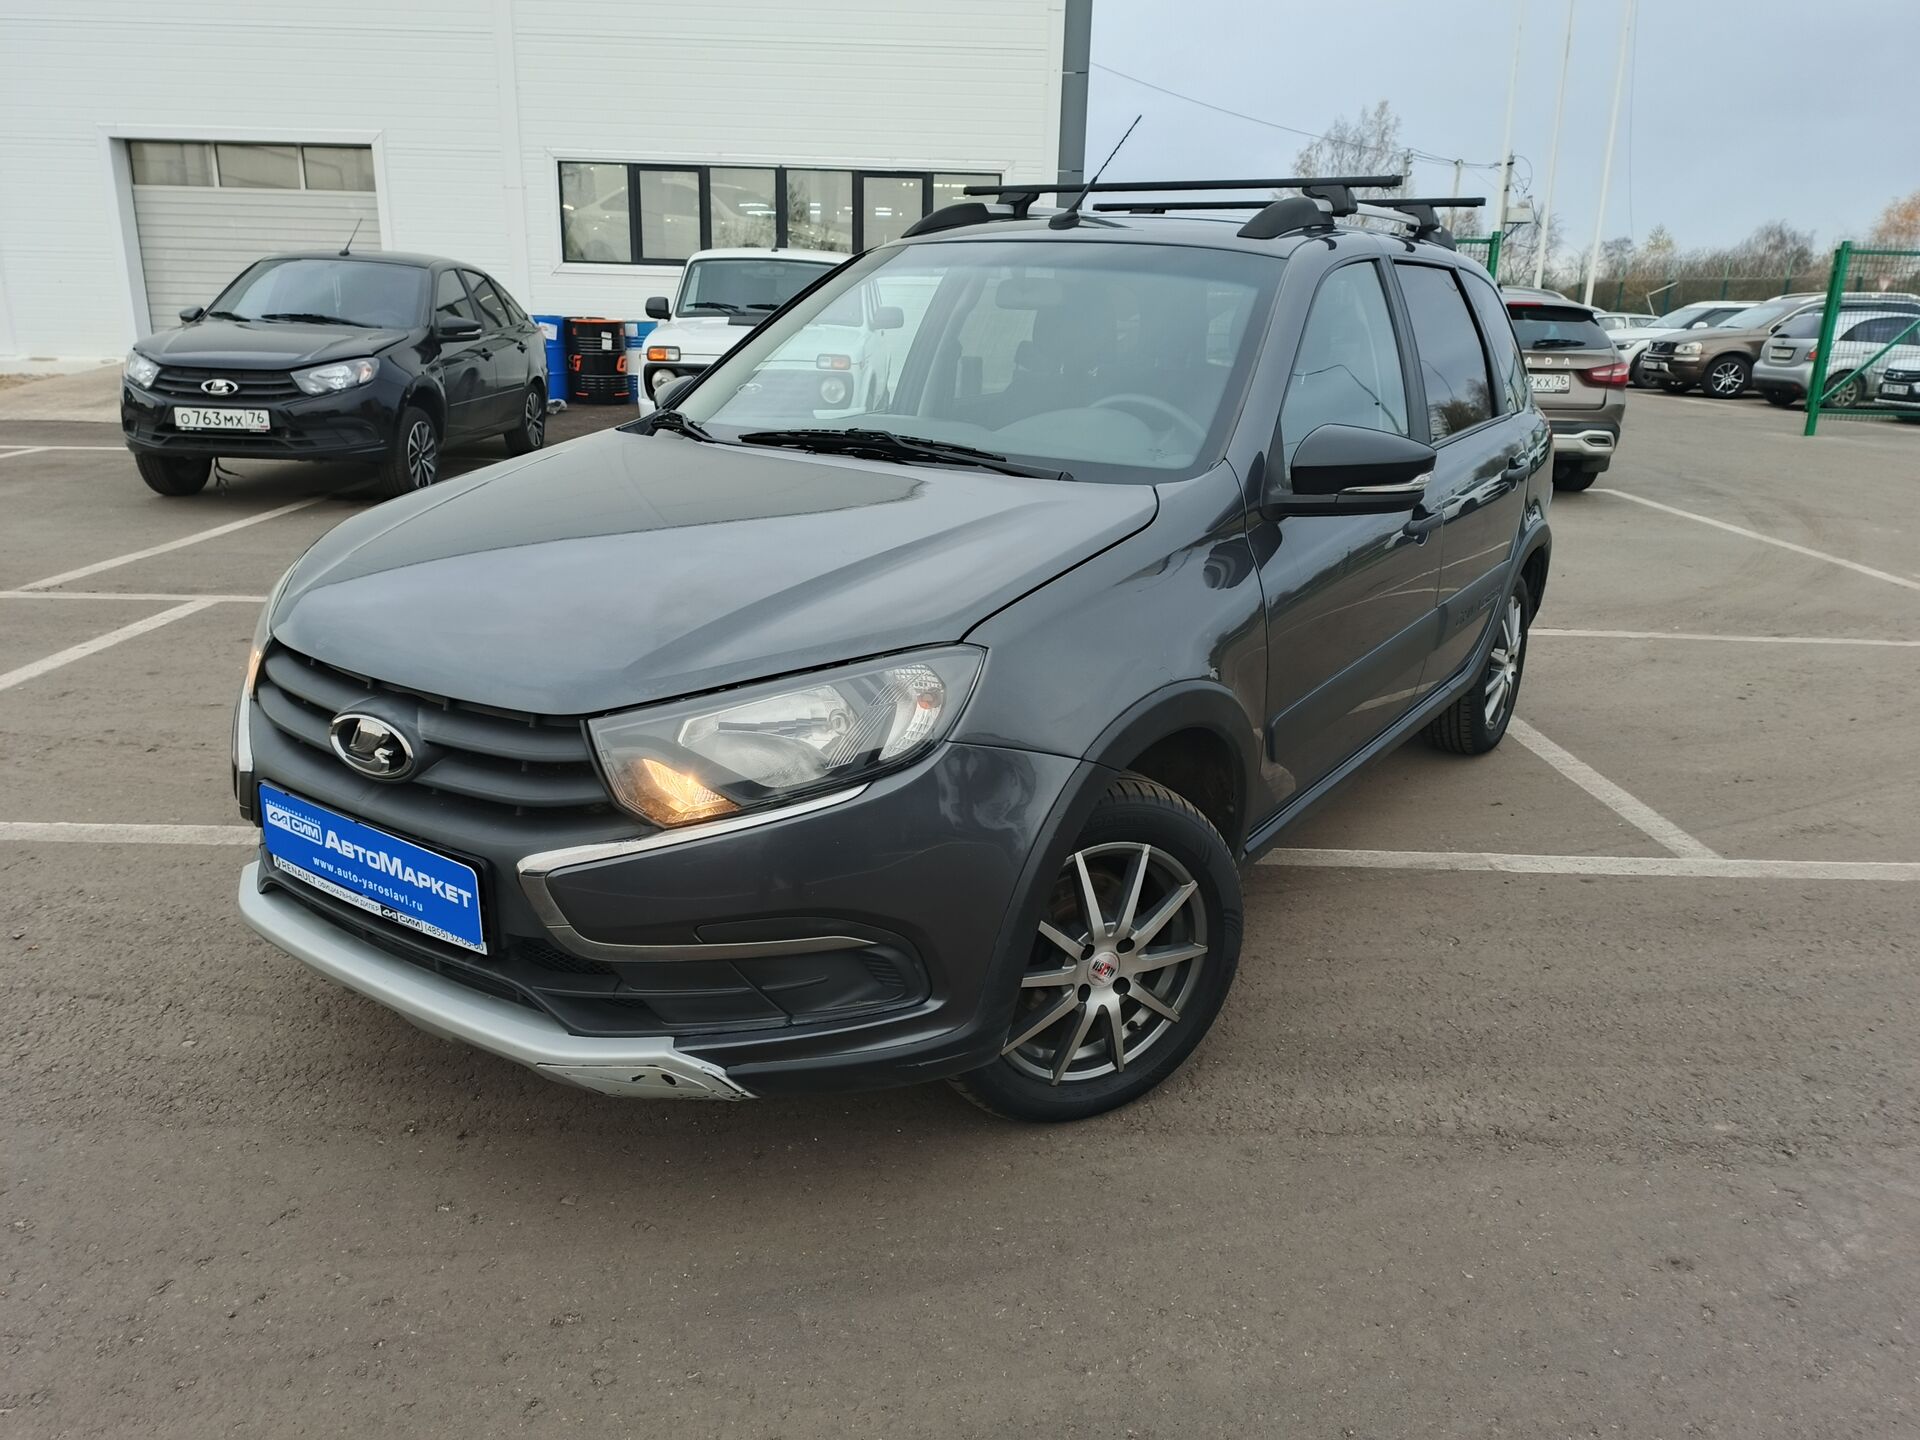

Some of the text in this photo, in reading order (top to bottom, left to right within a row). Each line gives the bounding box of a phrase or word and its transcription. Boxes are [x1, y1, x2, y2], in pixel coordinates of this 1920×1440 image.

[1525, 356, 1570, 366] ADA
[249, 412, 264, 424] 76
[291, 818, 320, 840] СИМ
[282, 861, 317, 885] RENAULT
[313, 856, 423, 912] www.auto-yaroslavl.ru
